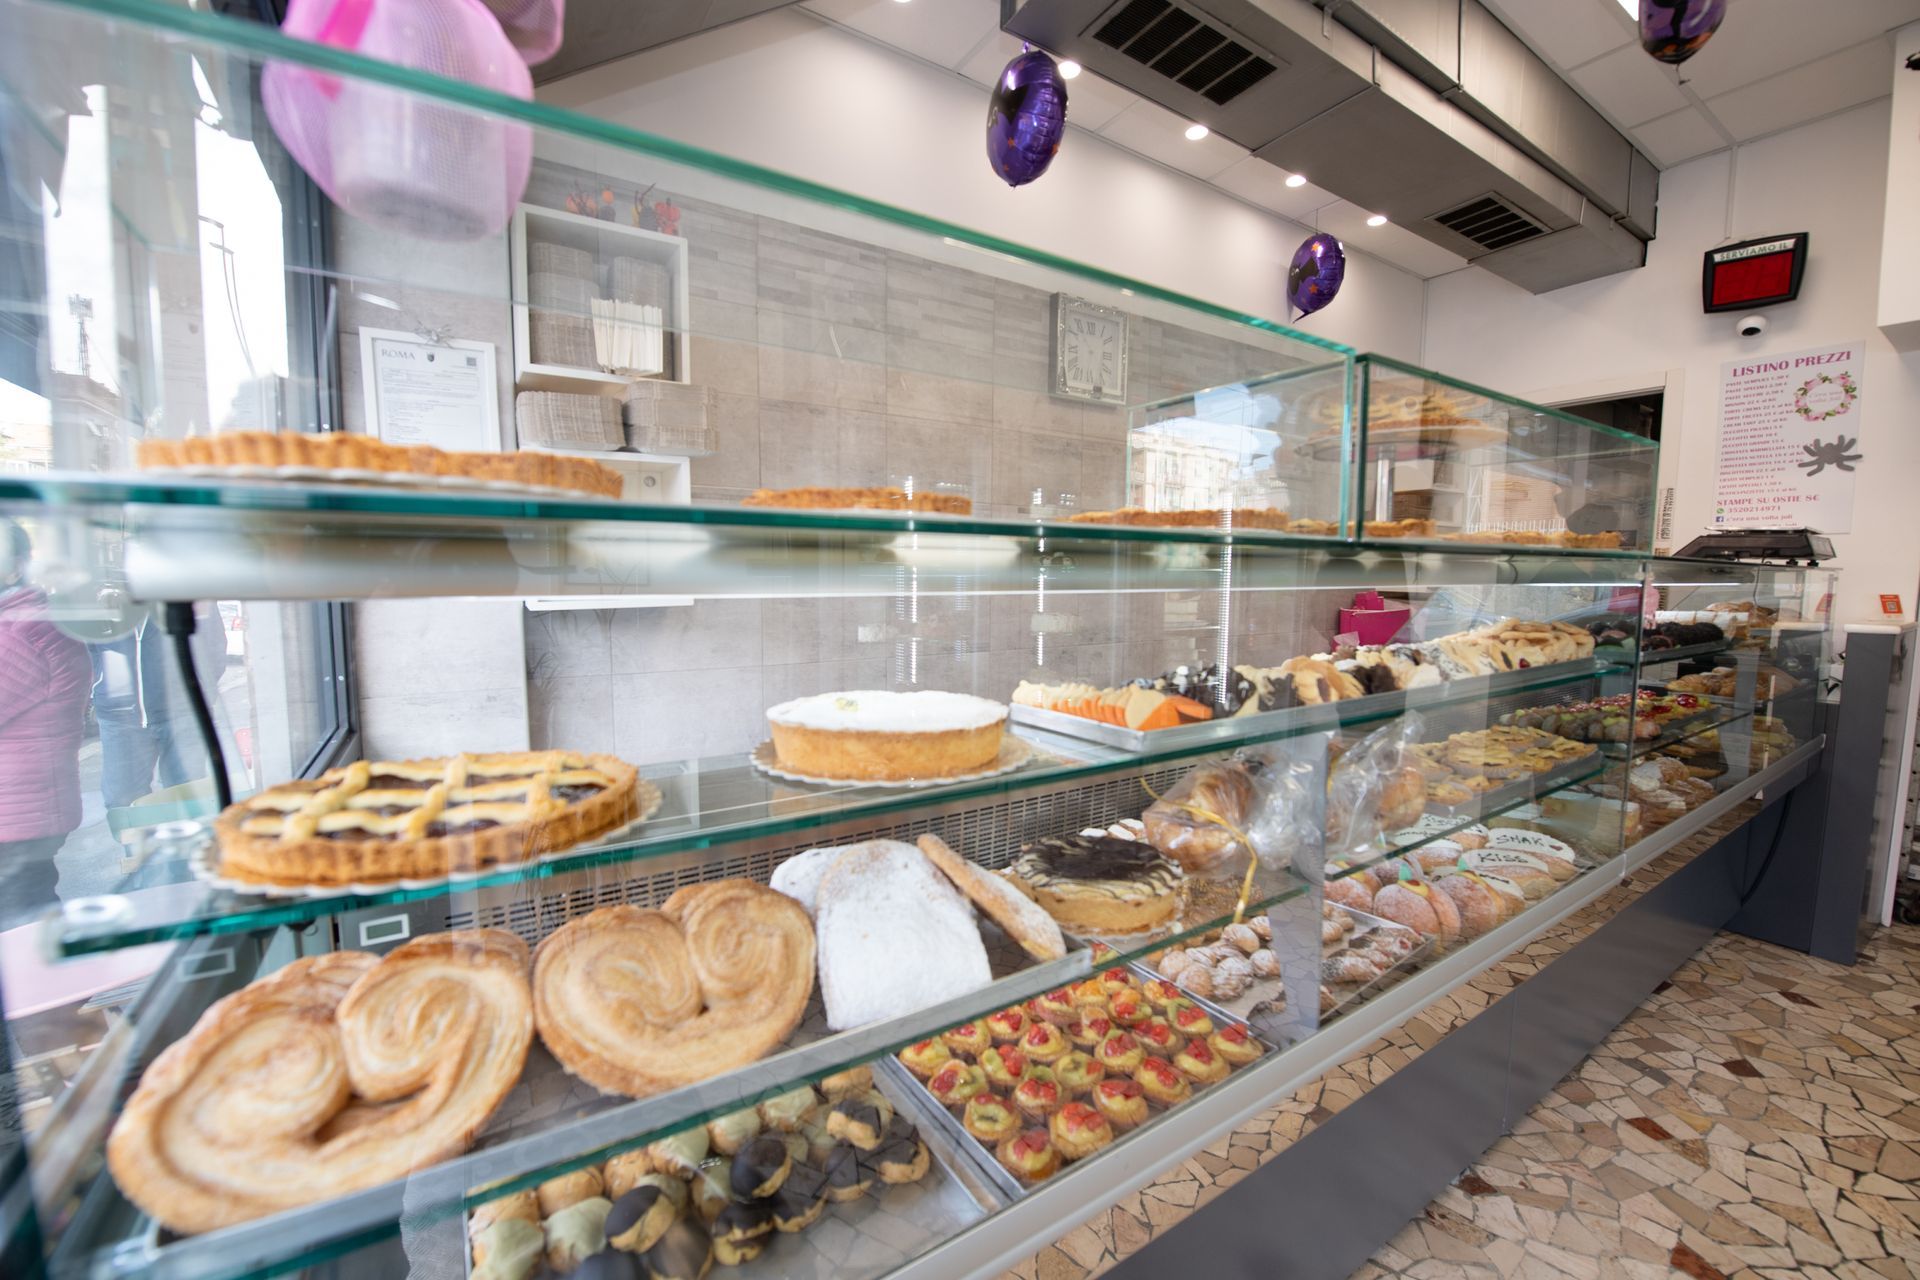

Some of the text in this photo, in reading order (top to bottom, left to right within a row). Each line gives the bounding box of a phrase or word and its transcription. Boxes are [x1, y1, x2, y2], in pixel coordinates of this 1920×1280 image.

[1720, 242, 1788, 260] SERVIAMO IL
[381, 348, 415, 360] ROMA
[1733, 350, 1851, 377] LISTINO PREZZI
[1728, 505, 1781, 514] 3520214971
[1496, 834, 1545, 847] SMAK
[1477, 852, 1529, 864] KISS
